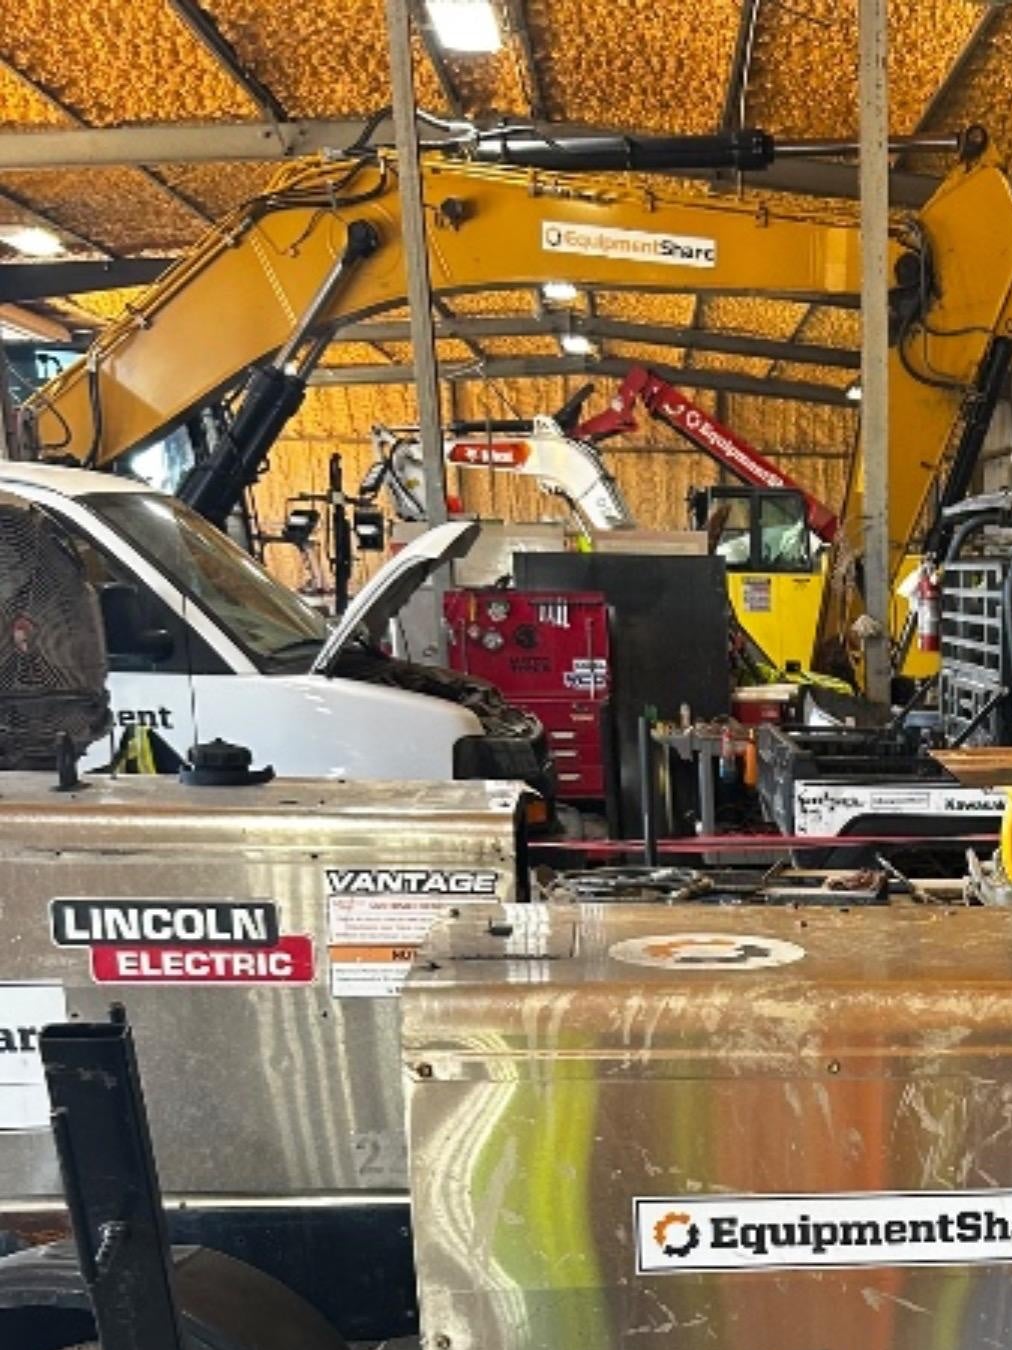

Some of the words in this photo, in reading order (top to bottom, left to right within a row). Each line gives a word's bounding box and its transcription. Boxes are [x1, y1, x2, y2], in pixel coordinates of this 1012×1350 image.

[328, 871, 498, 893] VANTAGE
[64, 907, 268, 940] LINCOLN
[116, 951, 294, 977] ELECTRIC
